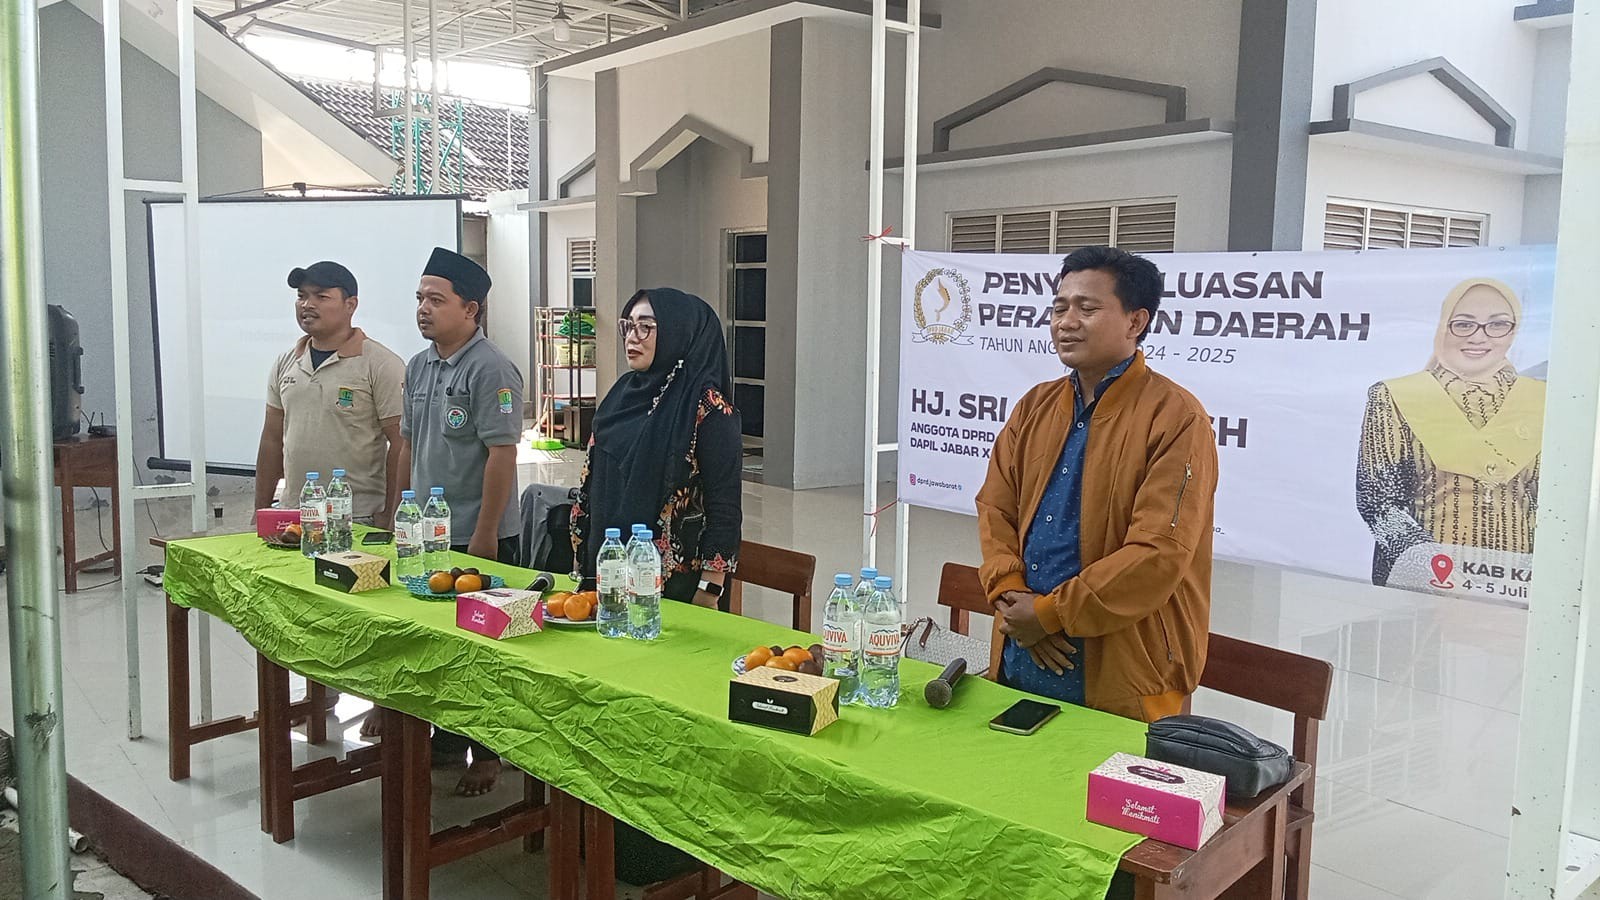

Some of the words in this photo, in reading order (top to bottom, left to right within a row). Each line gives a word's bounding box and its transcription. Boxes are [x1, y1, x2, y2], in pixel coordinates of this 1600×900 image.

[1193, 311, 1371, 341] DAERAH
[980, 336, 1023, 353] TAHUN
[1187, 347, 1237, 364] 2025
[911, 388, 951, 417] HJ.
[958, 393, 1008, 422] SRI
[910, 422, 960, 439] ANGGOTA
[962, 429, 996, 443] DPRD
[910, 437, 939, 452] DAPIL
[940, 442, 979, 458] JABAR
[1462, 561, 1505, 579] KAB
[1462, 580, 1473, 590] 4
[1486, 583, 1495, 594] 5
[1499, 585, 1528, 599] Juli
